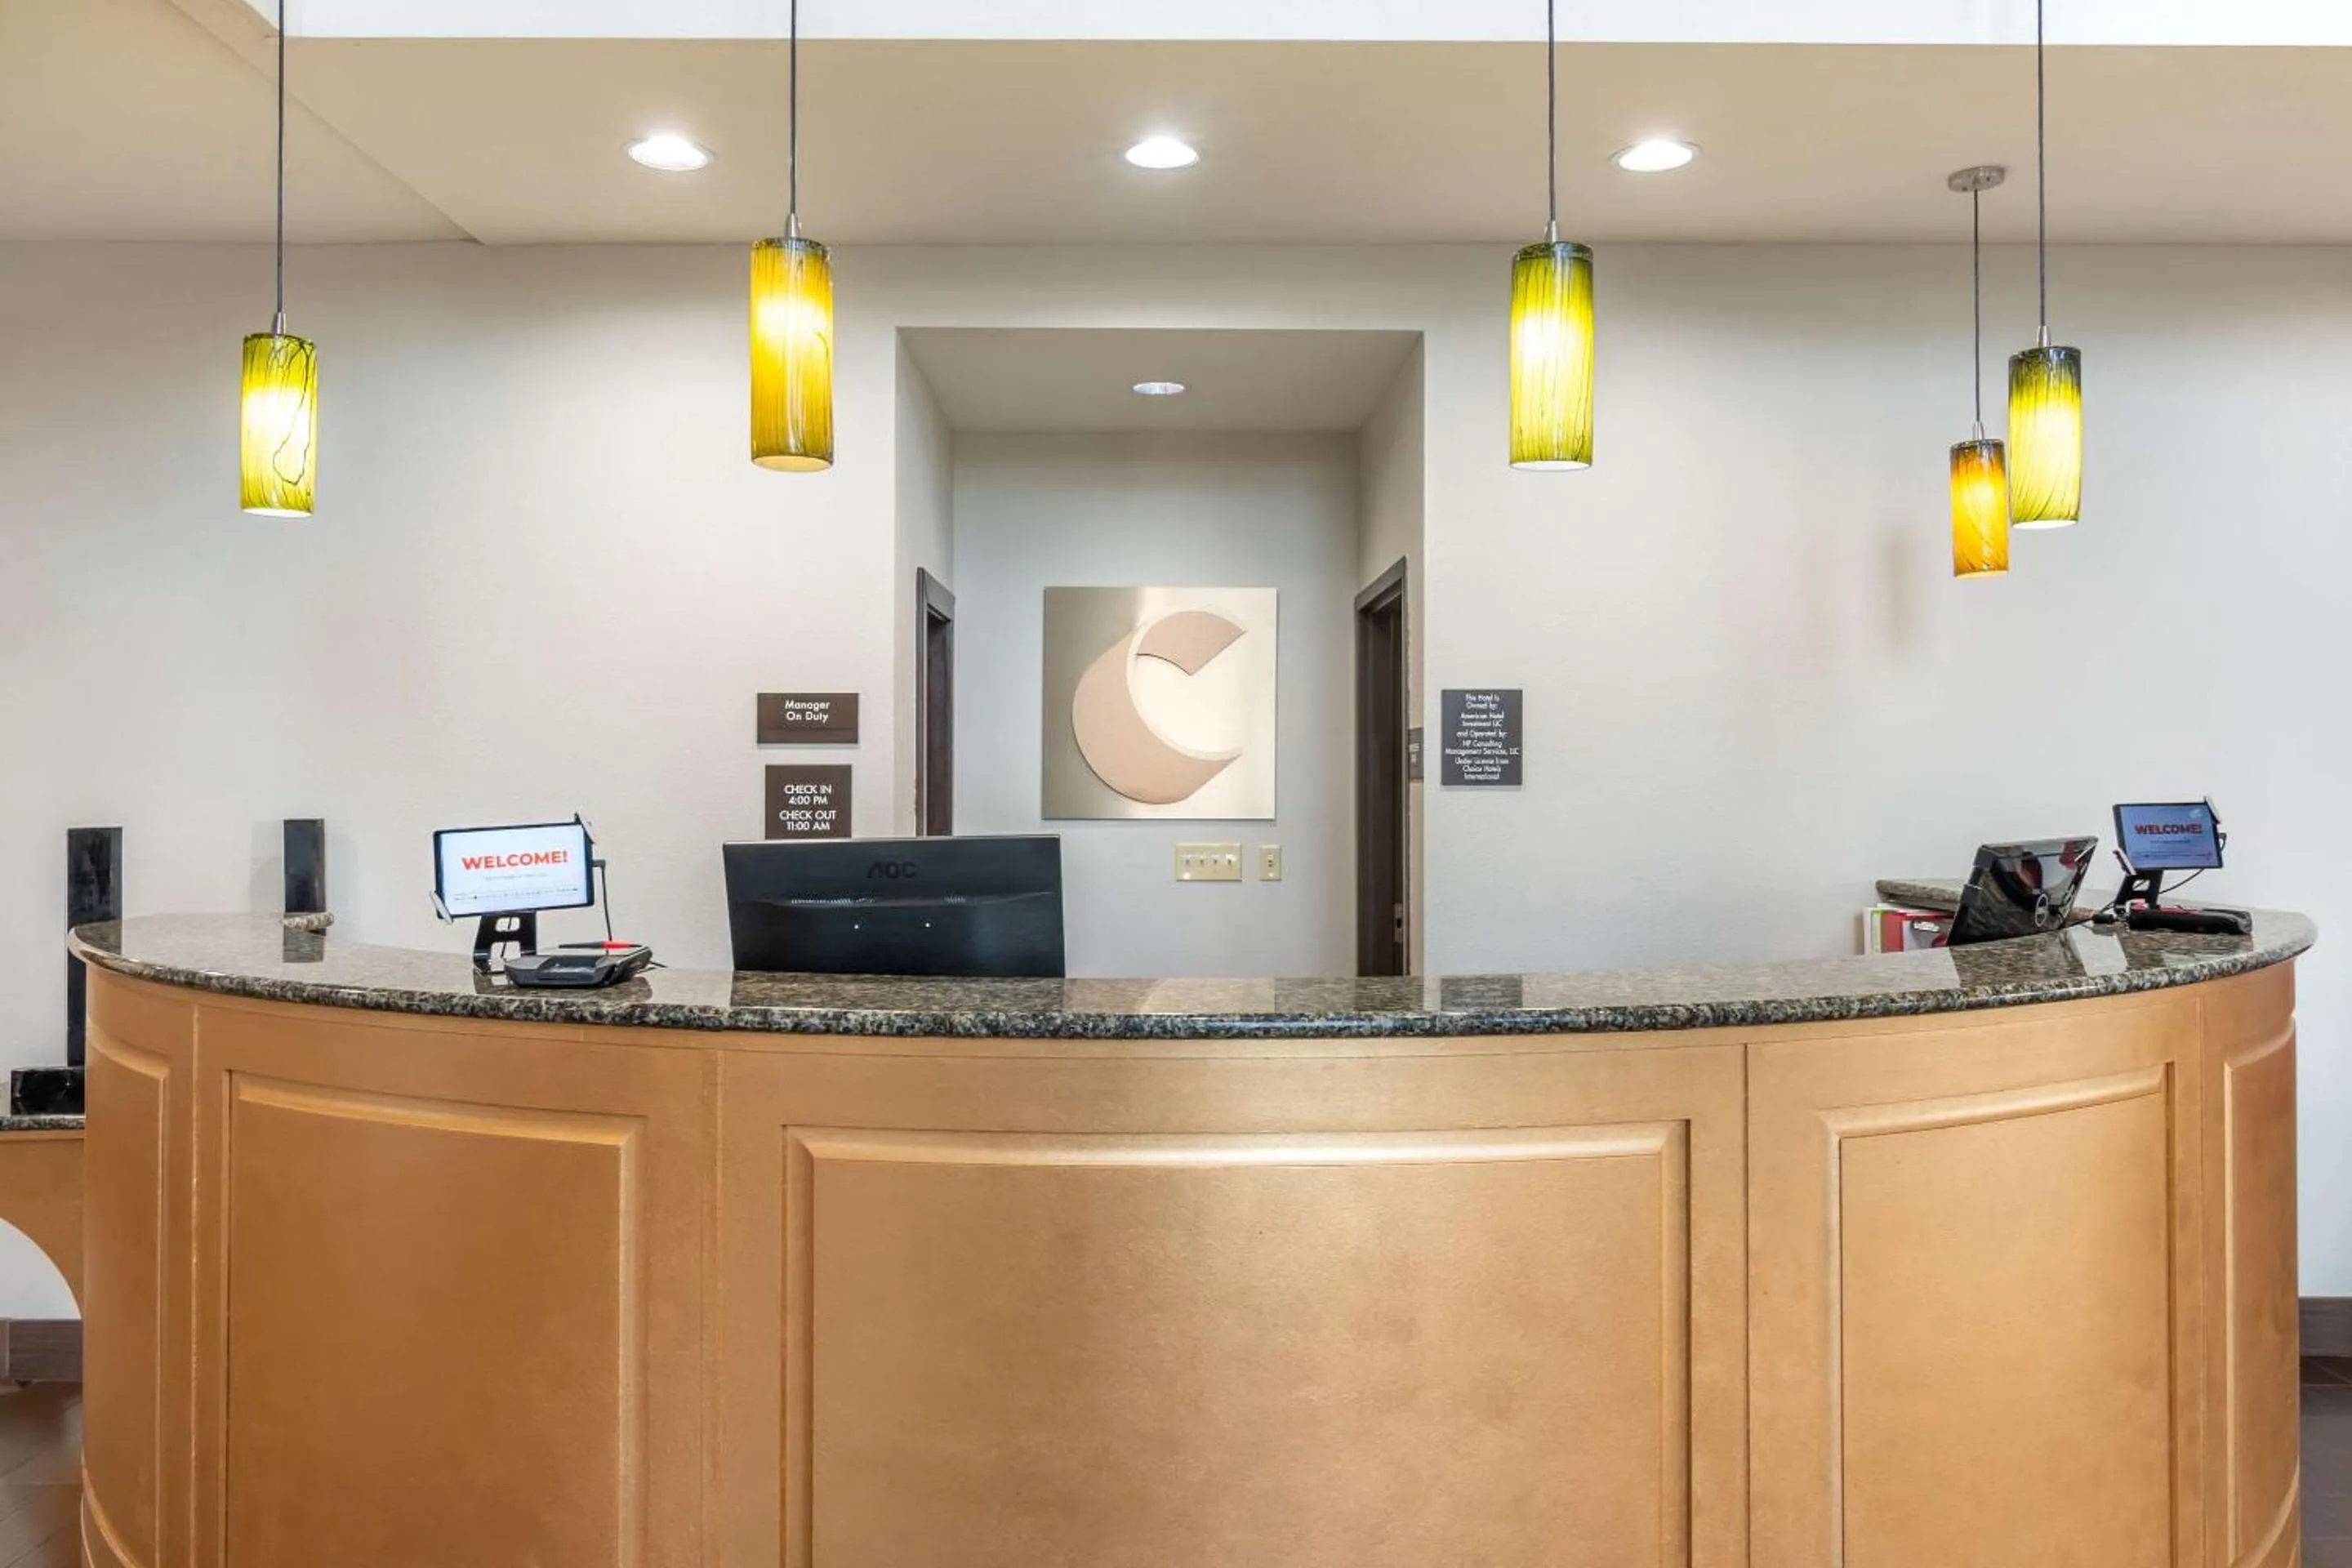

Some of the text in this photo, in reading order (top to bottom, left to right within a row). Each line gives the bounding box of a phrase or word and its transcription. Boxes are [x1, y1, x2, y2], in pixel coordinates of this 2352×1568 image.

[1478, 693, 1493, 702] Hotel
[785, 699, 831, 711] Manager
[786, 711, 829, 724] On Duty
[1456, 729, 1468, 737] and
[1469, 729, 1497, 738] Operated
[1472, 739, 1503, 748] Consulting
[1446, 748, 1482, 756] Management
[784, 785, 832, 795] CHECK IN
[789, 795, 828, 805] 4:00 PM
[779, 810, 837, 821] CHECK OUT
[786, 822, 831, 831] 11:00 AM
[2134, 823, 2203, 835] WELCOME!
[461, 849, 568, 871] WELCOME!
[866, 862, 917, 880] AOC
